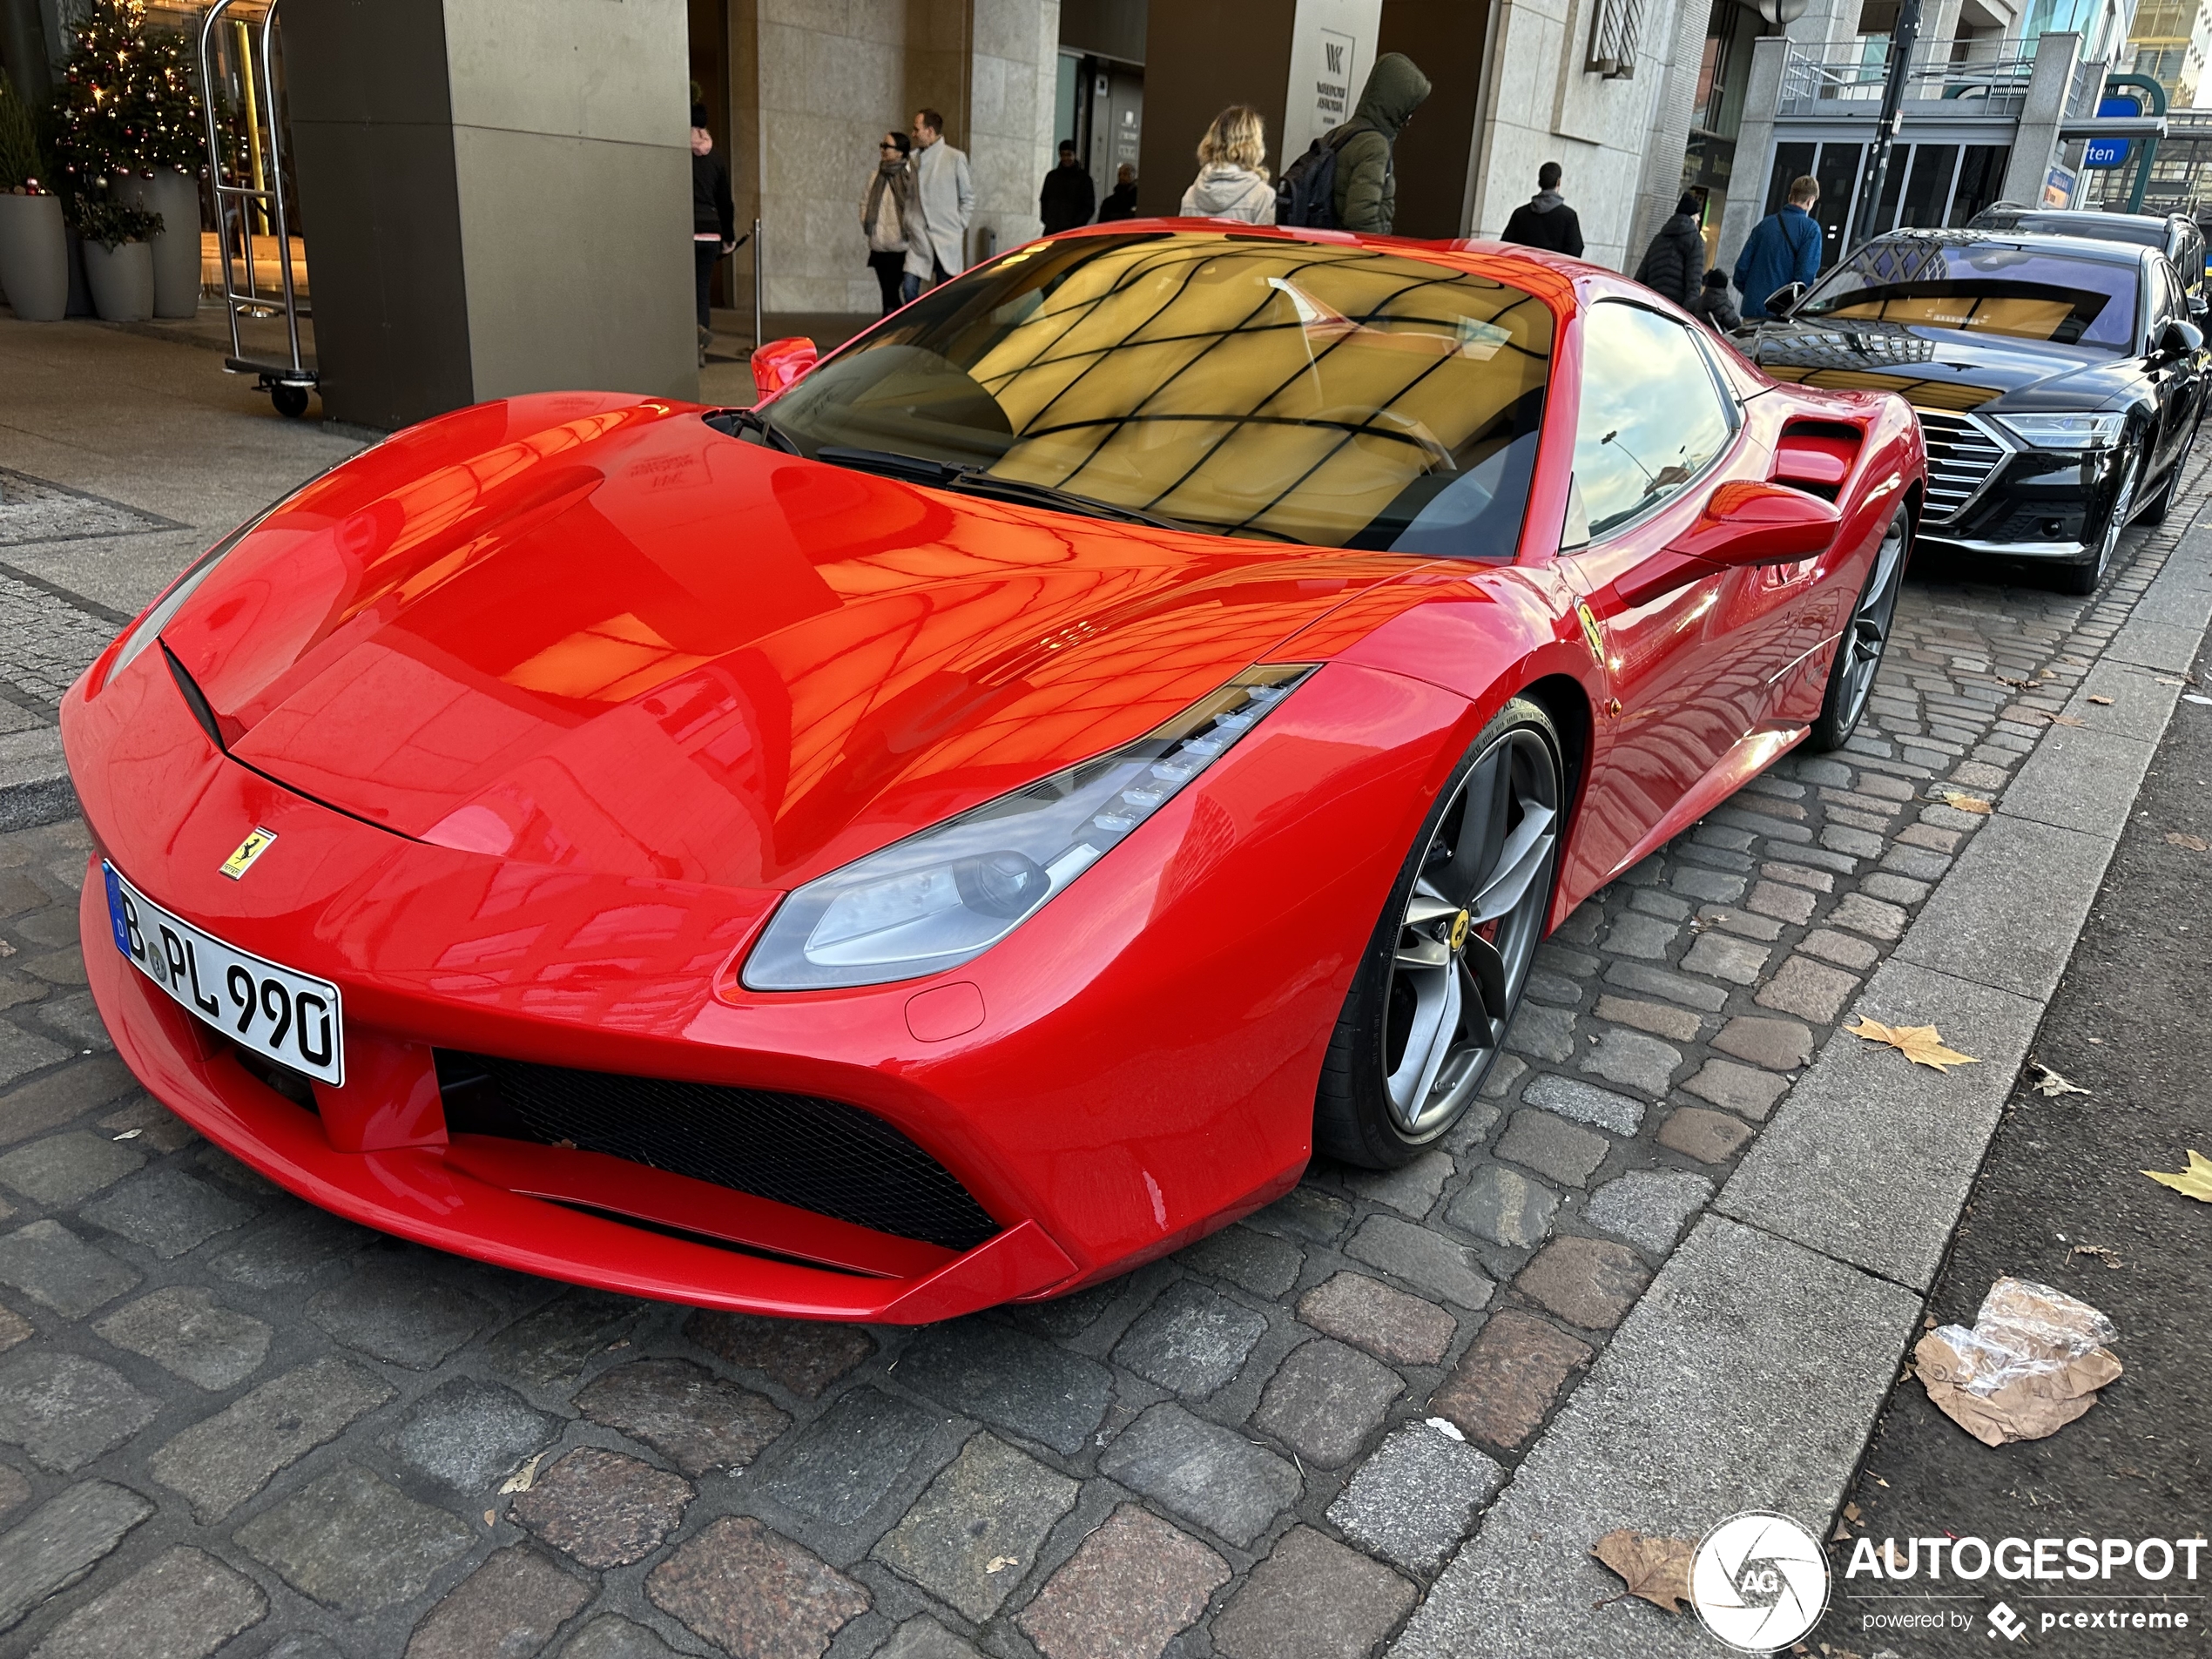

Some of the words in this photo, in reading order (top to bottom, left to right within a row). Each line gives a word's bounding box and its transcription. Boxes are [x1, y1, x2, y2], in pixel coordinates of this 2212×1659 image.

[116, 918, 125, 938] D
[121, 889, 146, 961] B
[158, 923, 220, 1018] PL
[226, 964, 333, 1067] 990
